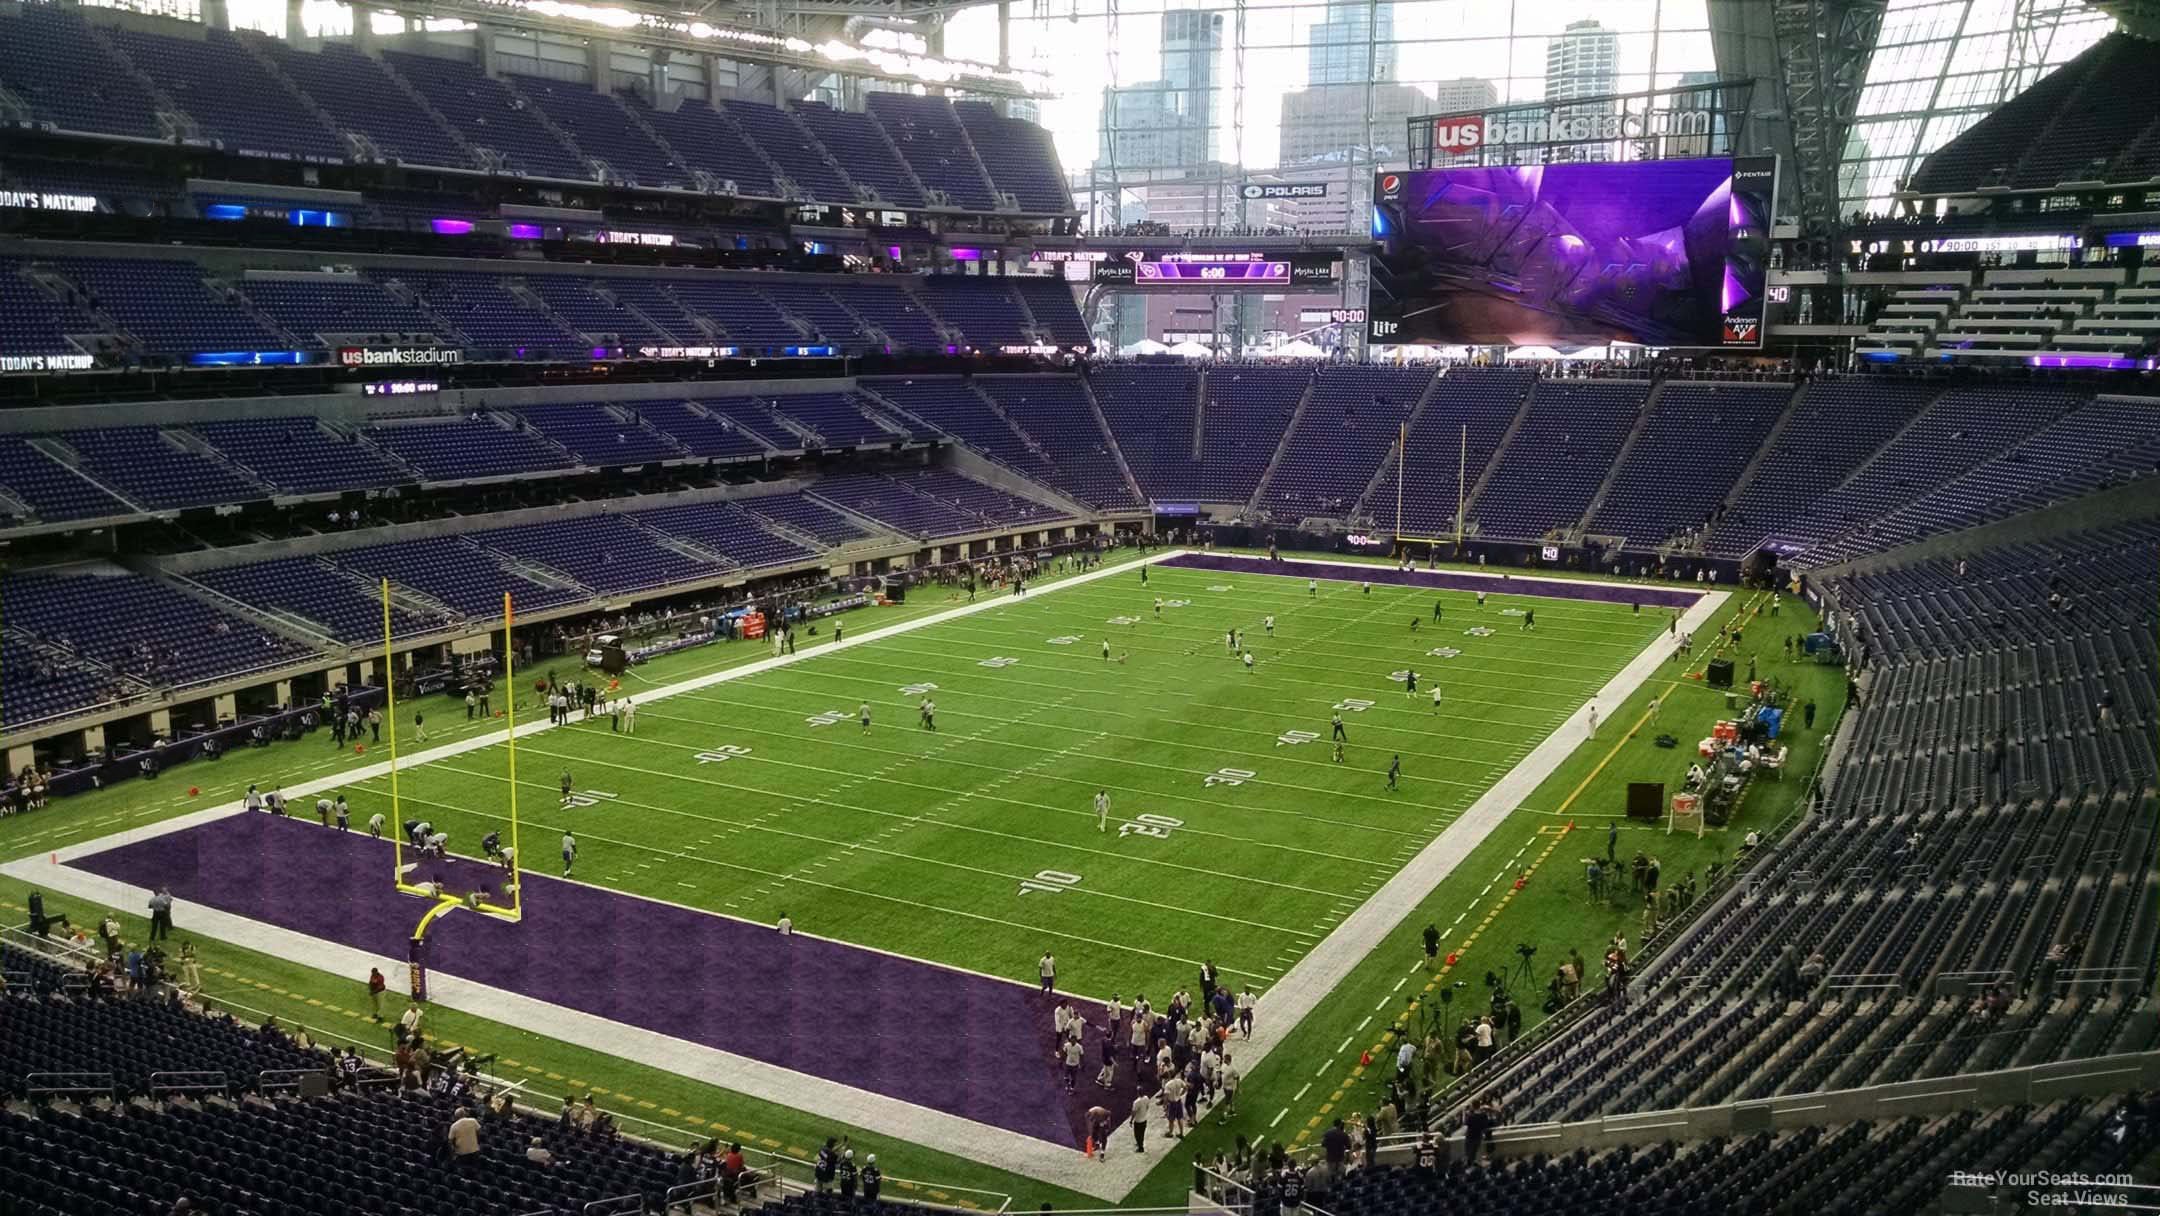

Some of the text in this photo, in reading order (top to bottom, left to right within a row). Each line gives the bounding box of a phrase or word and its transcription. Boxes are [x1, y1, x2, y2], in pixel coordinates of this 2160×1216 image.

[1265, 185, 1323, 196] POLARIS
[42, 194, 96, 212] MATCHUP
[1947, 241, 1979, 251] 90:00
[1769, 287, 1788, 301] 40
[1332, 310, 1365, 323] 90:00
[1373, 320, 1398, 337] Lite
[0, 355, 94, 371] TODAY'S MATCHUP
[1118, 813, 1185, 839] 20
[1020, 869, 1083, 893] 10
[345, 1063, 356, 1073] 13
[1284, 1183, 1299, 1197] 26
